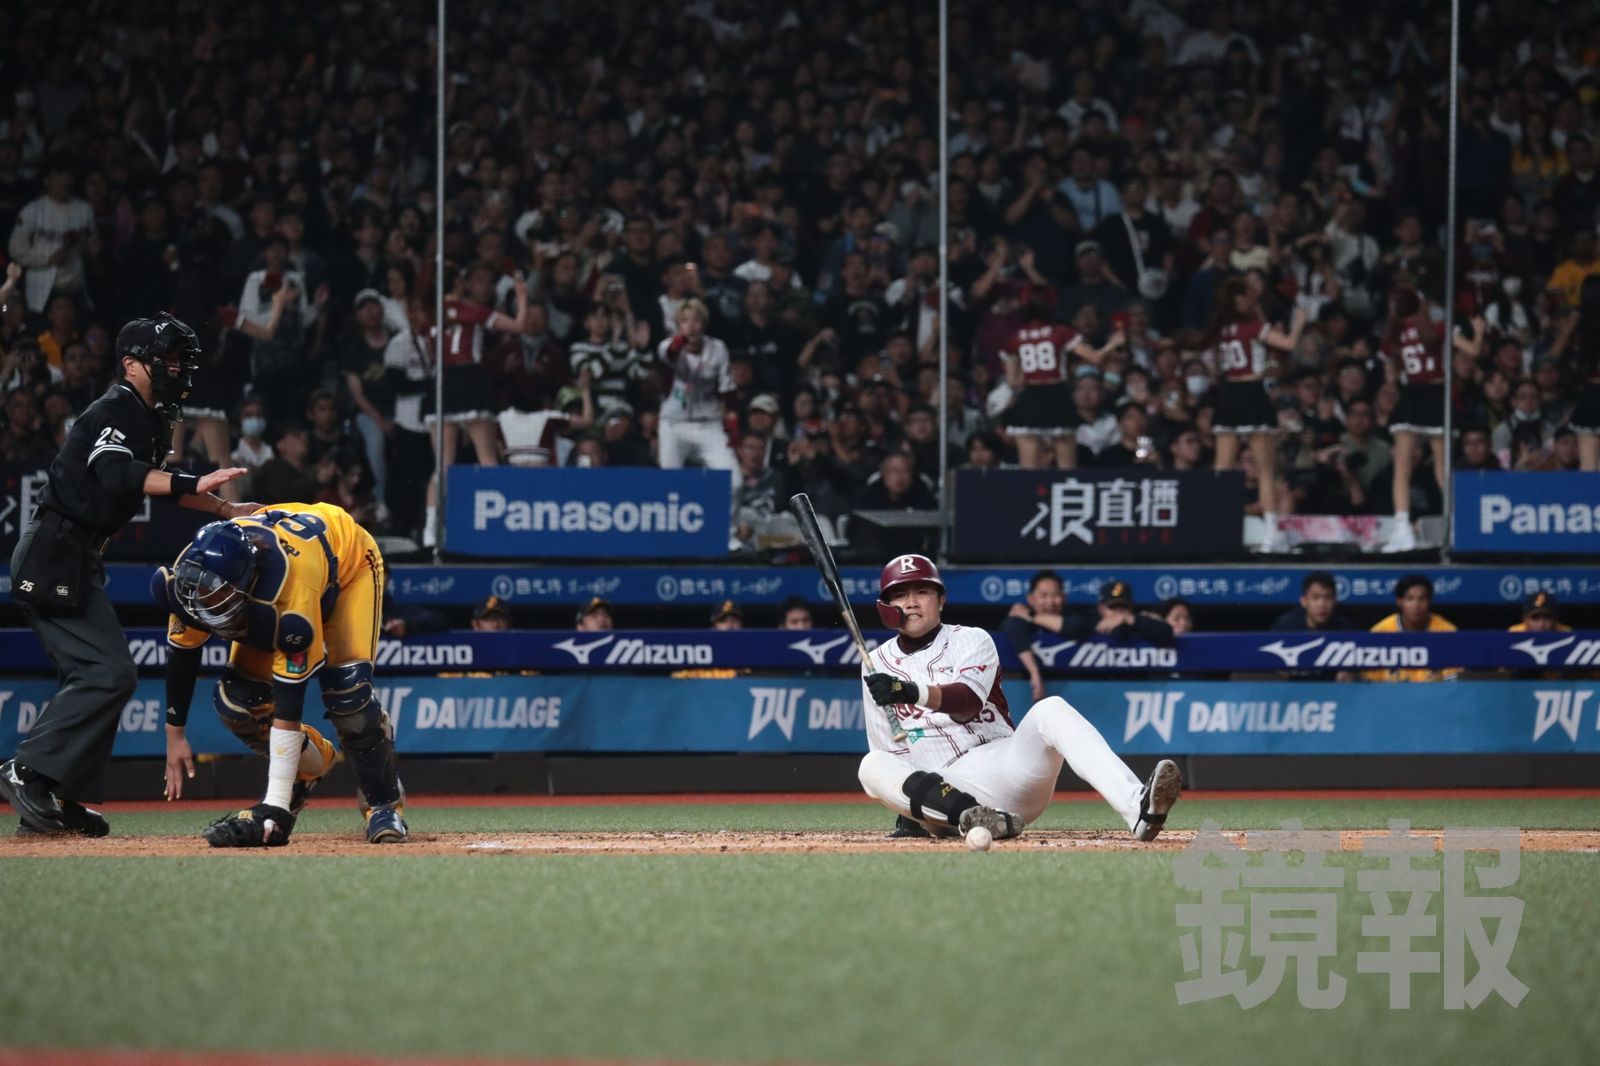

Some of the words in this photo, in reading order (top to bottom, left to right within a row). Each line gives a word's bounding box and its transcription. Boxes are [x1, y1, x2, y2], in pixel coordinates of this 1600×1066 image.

[1018, 341, 1056, 373] 88
[94, 427, 126, 447] 25
[474, 490, 704, 532] Panasonic
[900, 556, 920, 573] R
[20, 580, 35, 592] 25
[416, 697, 562, 729] DAVILLAGE
[1187, 702, 1337, 732] DAVILLAGE
